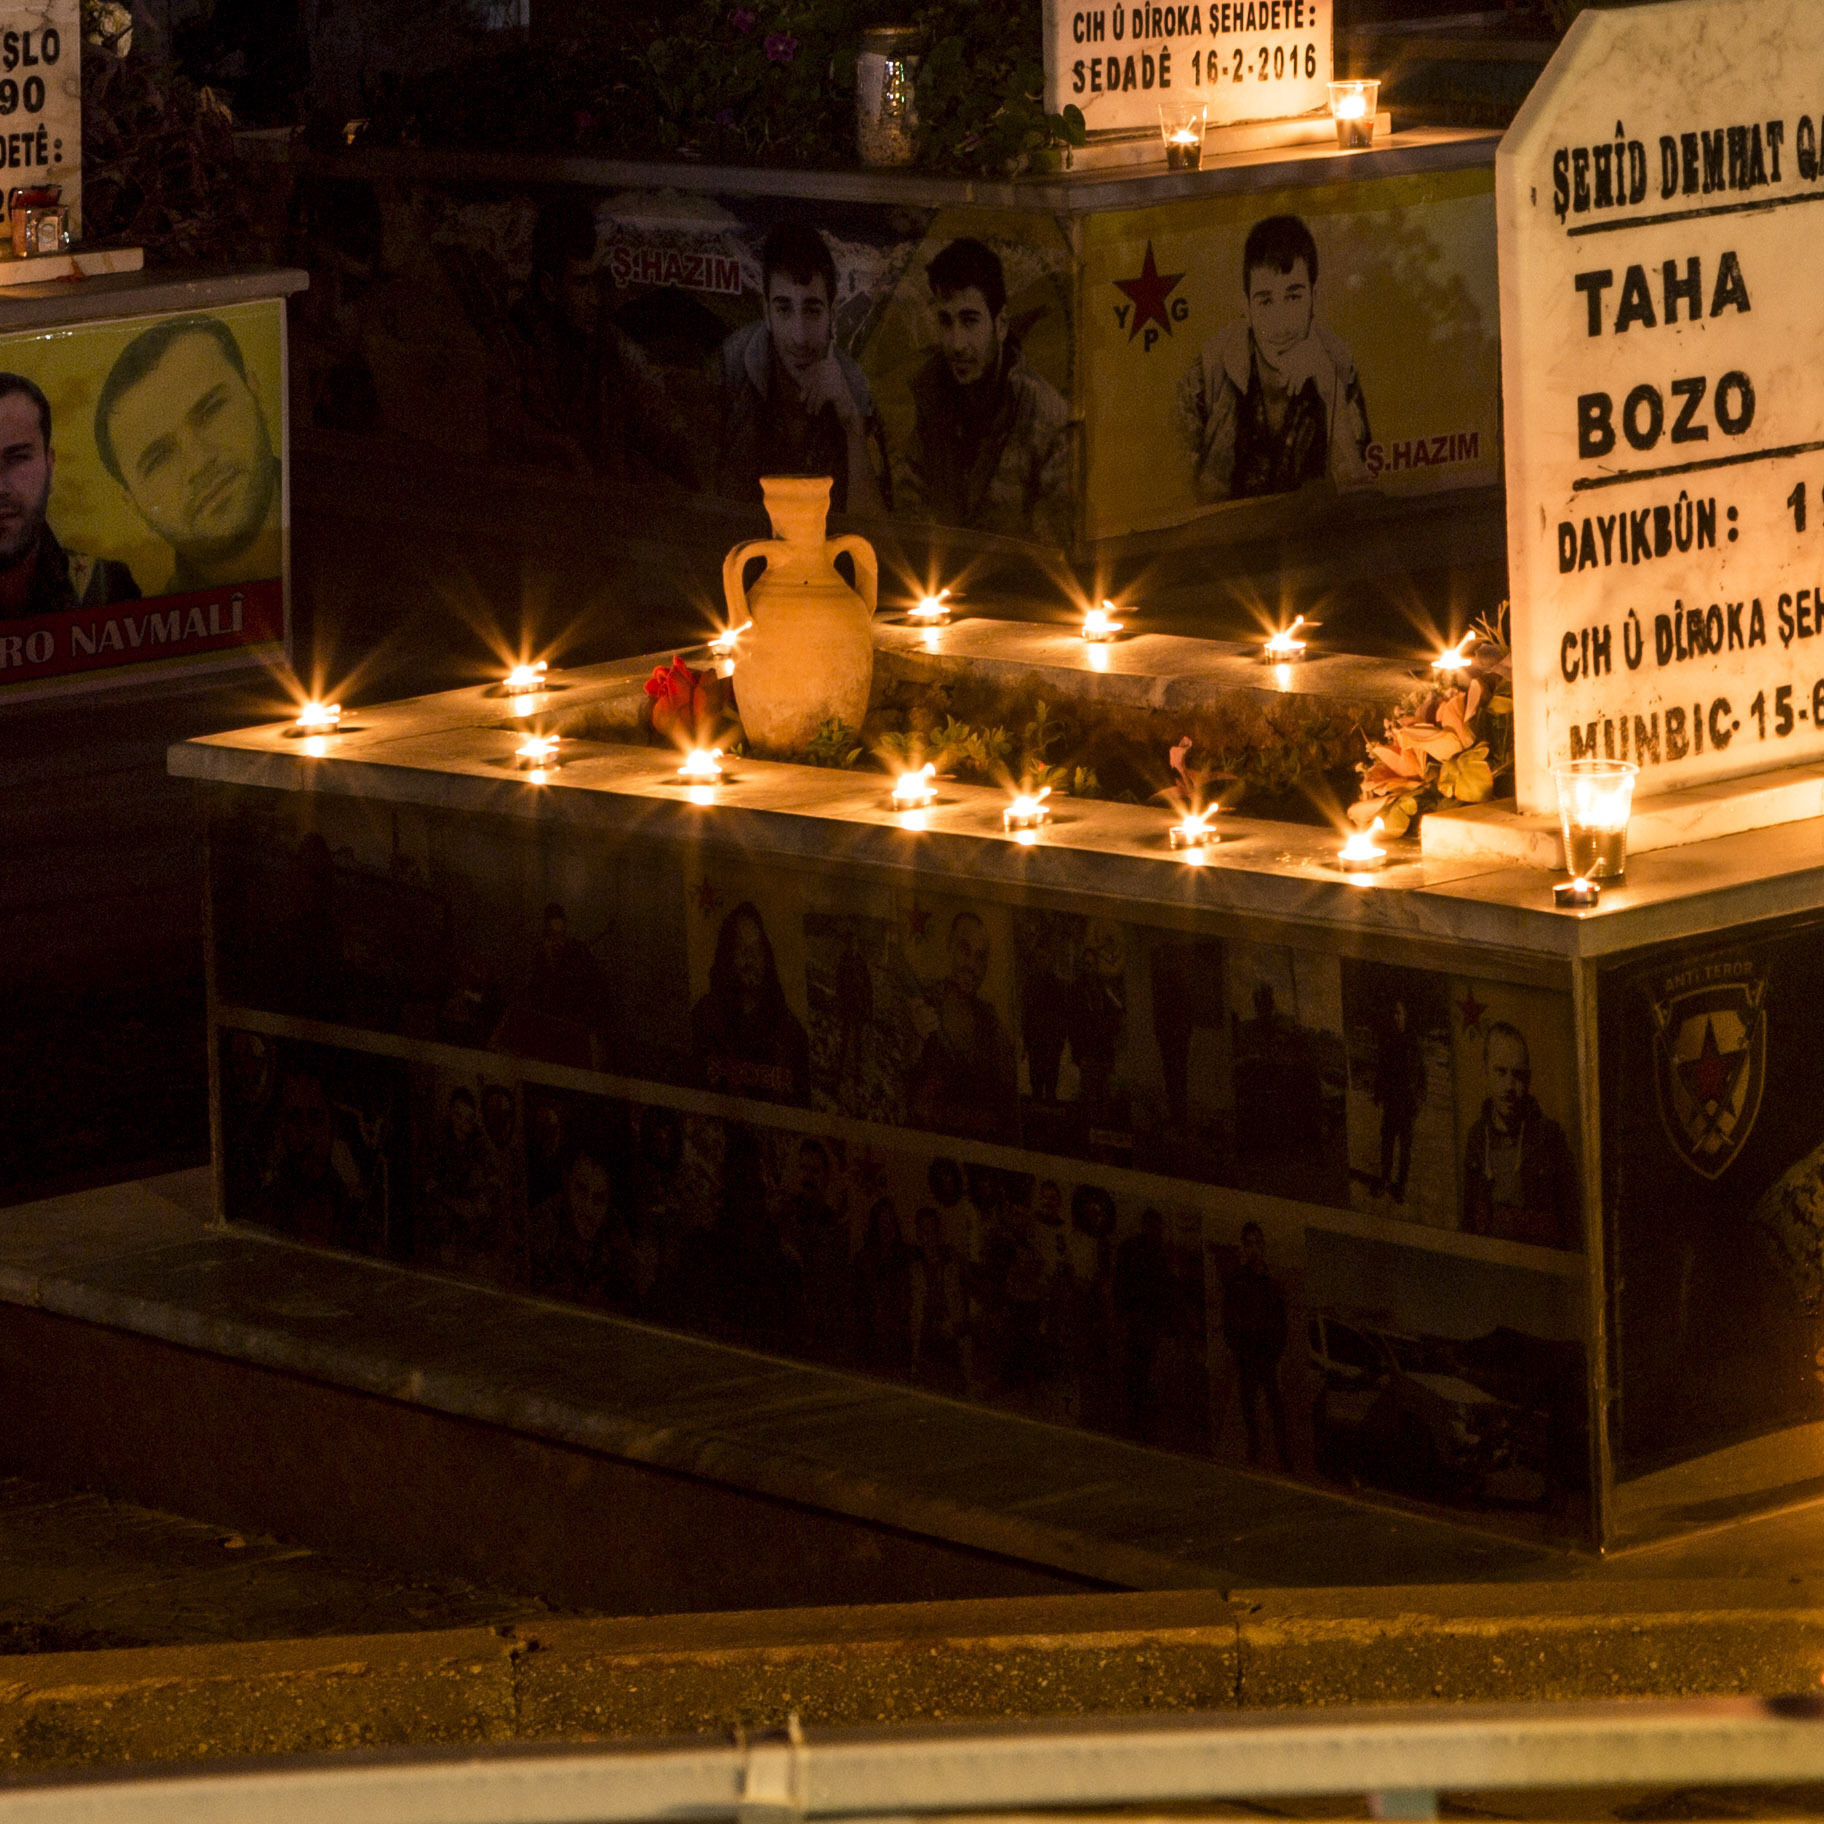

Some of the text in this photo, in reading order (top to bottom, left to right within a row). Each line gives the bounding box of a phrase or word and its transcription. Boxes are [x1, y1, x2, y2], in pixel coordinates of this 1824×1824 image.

[1192, 44, 1316, 86] 16-2-2016
[1554, 121, 1647, 216] ŞEHÎD
[1661, 120, 1783, 197] DEMHAT
[1576, 251, 1751, 336] TAHA
[1578, 371, 1756, 459] BOZO
[71, 593, 244, 657] NAVMALÎ
